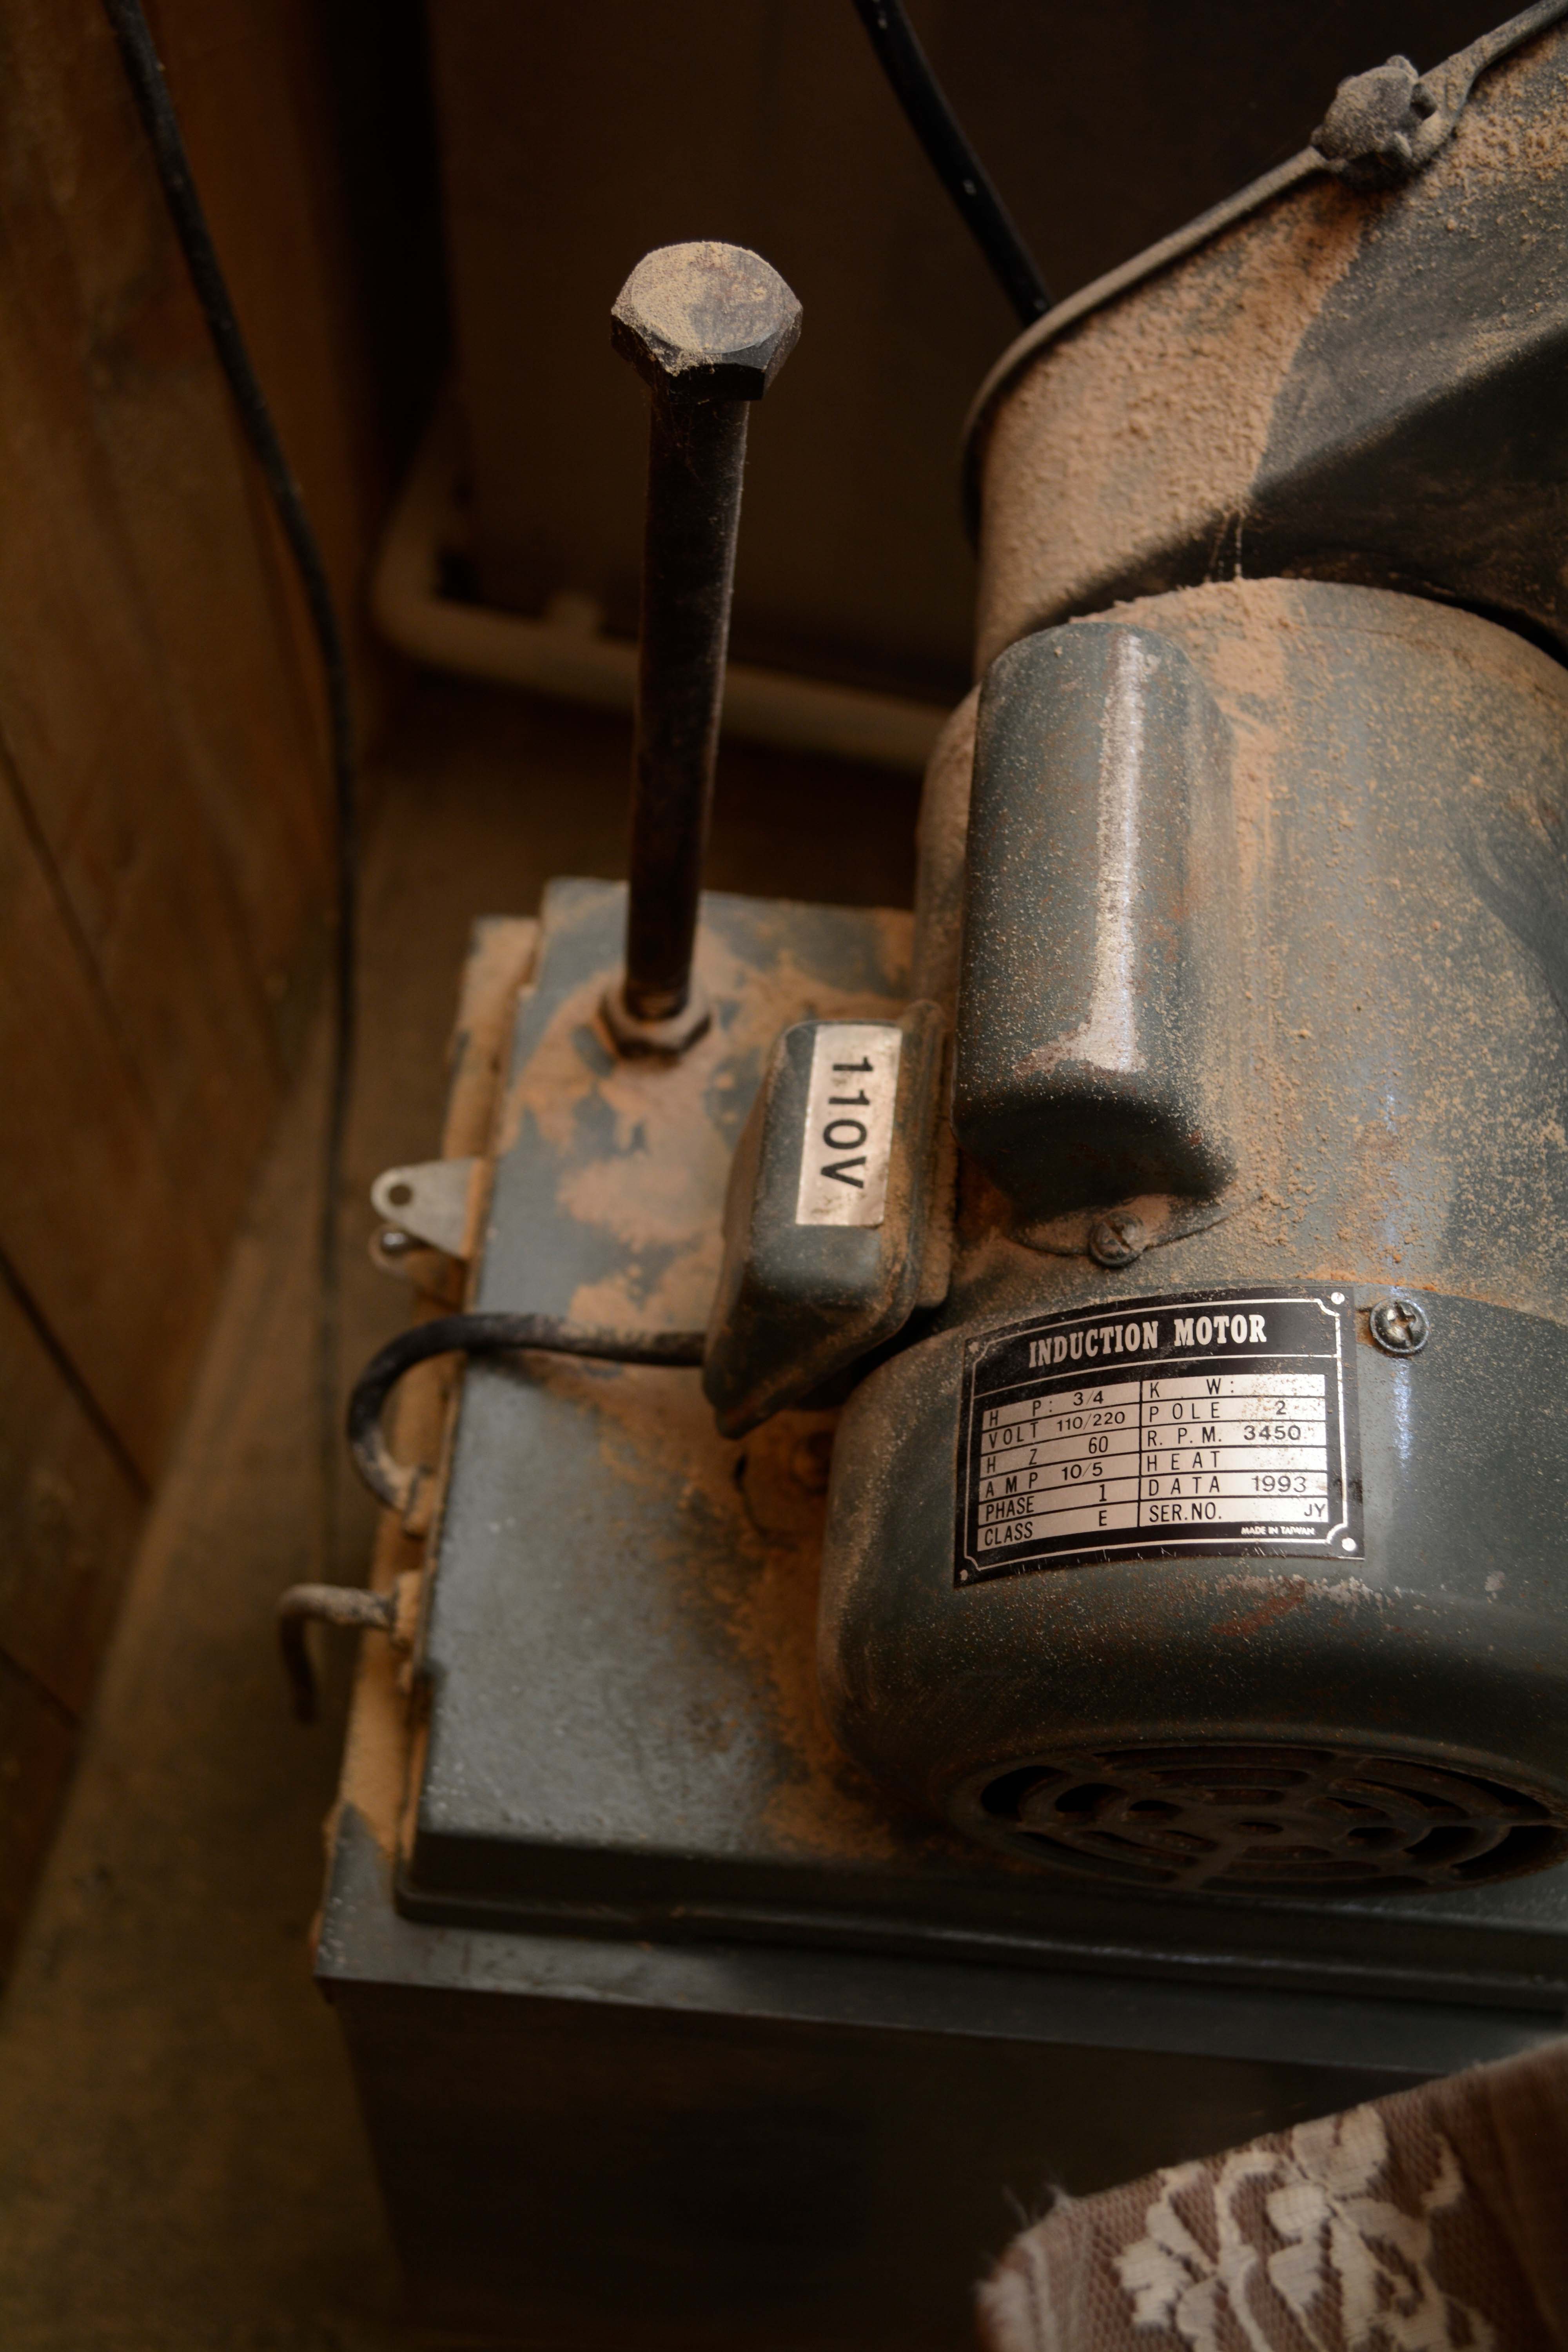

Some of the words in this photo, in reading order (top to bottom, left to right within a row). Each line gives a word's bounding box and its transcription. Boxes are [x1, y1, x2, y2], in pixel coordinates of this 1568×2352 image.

[820, 1057, 874, 1189] 110V
[1029, 1321, 1159, 1368] INDUCTION
[1174, 1314, 1267, 1346] MOTOR
[1073, 1390, 1103, 1406] 3/4
[1149, 1402, 1220, 1422] POLE
[1276, 1401, 1286, 1415] 2
[989, 1422, 1038, 1448] VOLT
[1057, 1412, 1125, 1432] 110/220
[1243, 1425, 1301, 1441] 3450
[1089, 1436, 1108, 1454] 60
[1062, 1462, 1103, 1480] 10/5
[1147, 1451, 1220, 1472] HEAT
[1149, 1476, 1220, 1496] DATA
[1252, 1475, 1306, 1492] 1993
[986, 1496, 1034, 1522] PHASE
[1099, 1484, 1107, 1502] 1
[1304, 1503, 1325, 1517] JY
[985, 1521, 1033, 1546] CLASS
[1099, 1510, 1107, 1526] E
[1241, 1526, 1266, 1535] MADE
[1268, 1526, 1278, 1534] IN
[1280, 1526, 1315, 1535] TAIWAN
